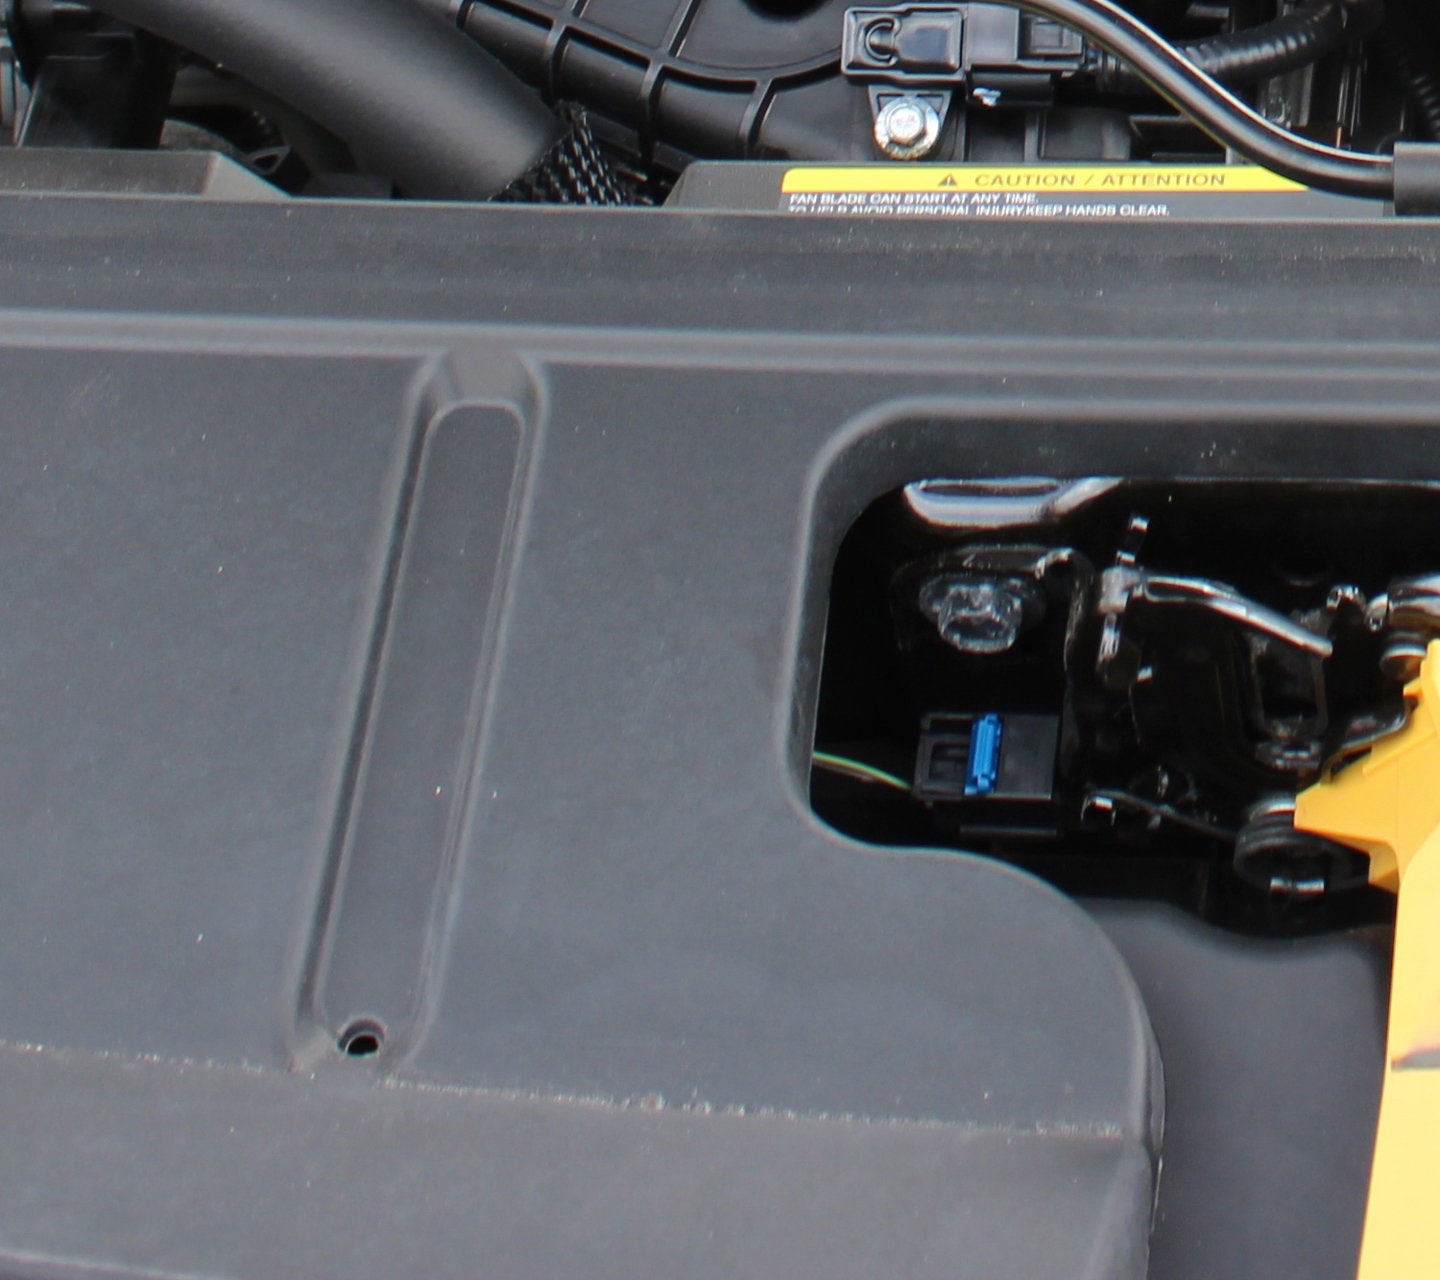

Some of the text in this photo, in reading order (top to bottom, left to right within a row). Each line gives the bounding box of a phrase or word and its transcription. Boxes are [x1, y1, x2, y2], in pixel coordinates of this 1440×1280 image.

[974, 173, 1076, 187] CAUTION
[1101, 173, 1226, 187] ATTENTION
[790, 192, 817, 204] FAN
[820, 192, 866, 204] BLADE
[870, 192, 901, 204] CAN
[904, 192, 948, 204] START
[951, 192, 967, 204] AT
[970, 192, 1001, 204] ANY
[1065, 204, 1117, 216] HANDS
